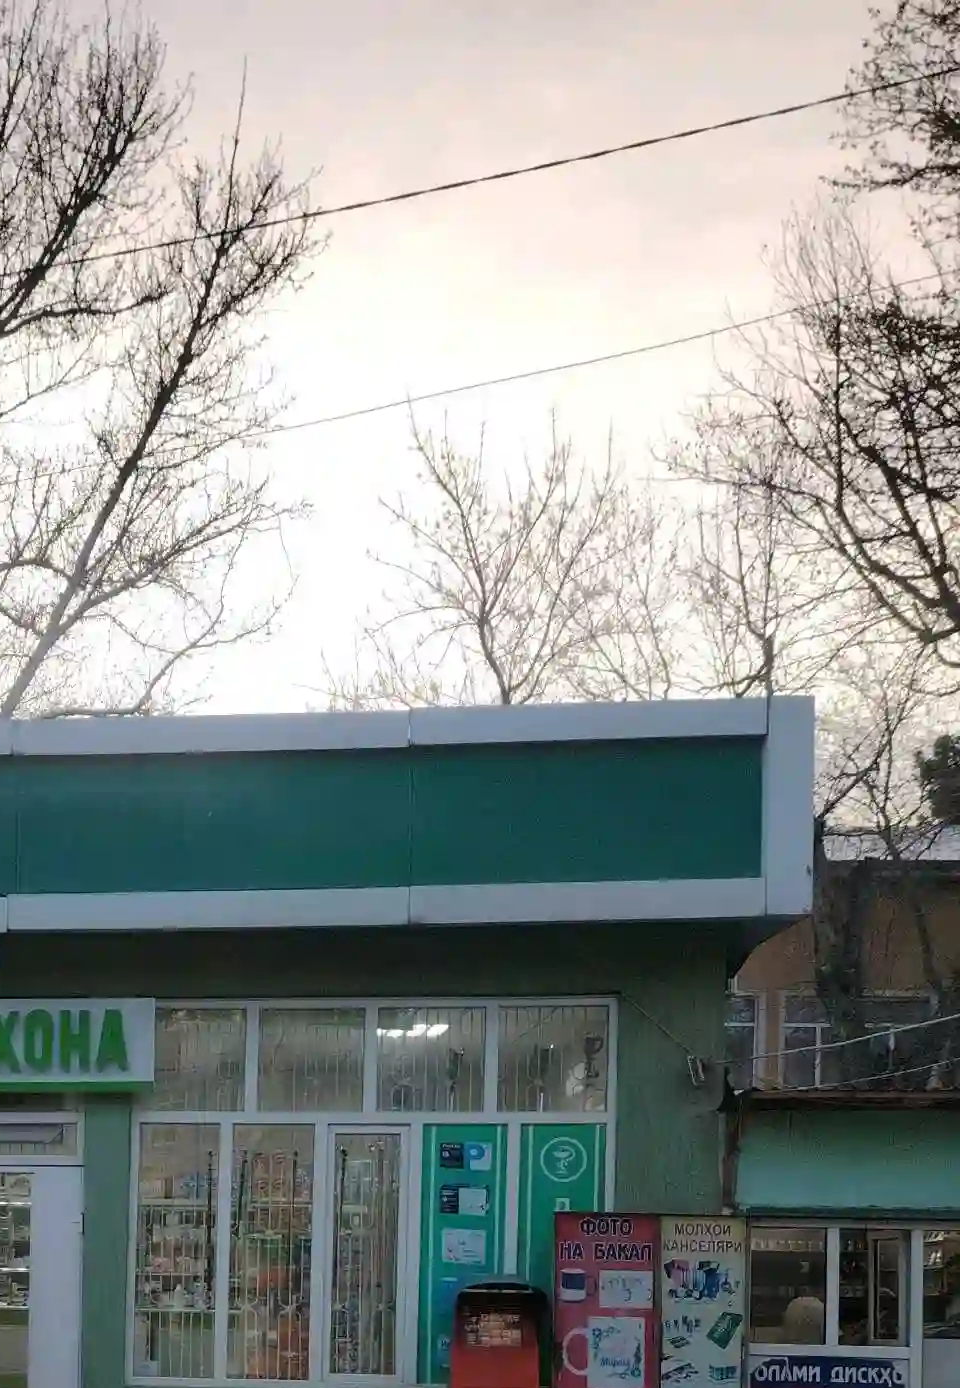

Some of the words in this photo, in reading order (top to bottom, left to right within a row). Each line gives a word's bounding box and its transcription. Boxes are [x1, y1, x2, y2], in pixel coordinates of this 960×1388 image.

[580, 1216, 632, 1236] ФОТО
[559, 1241, 583, 1260] НА
[594, 1242, 652, 1261] БАКАЛ
[756, 1364, 821, 1383] ОЛАМИ
